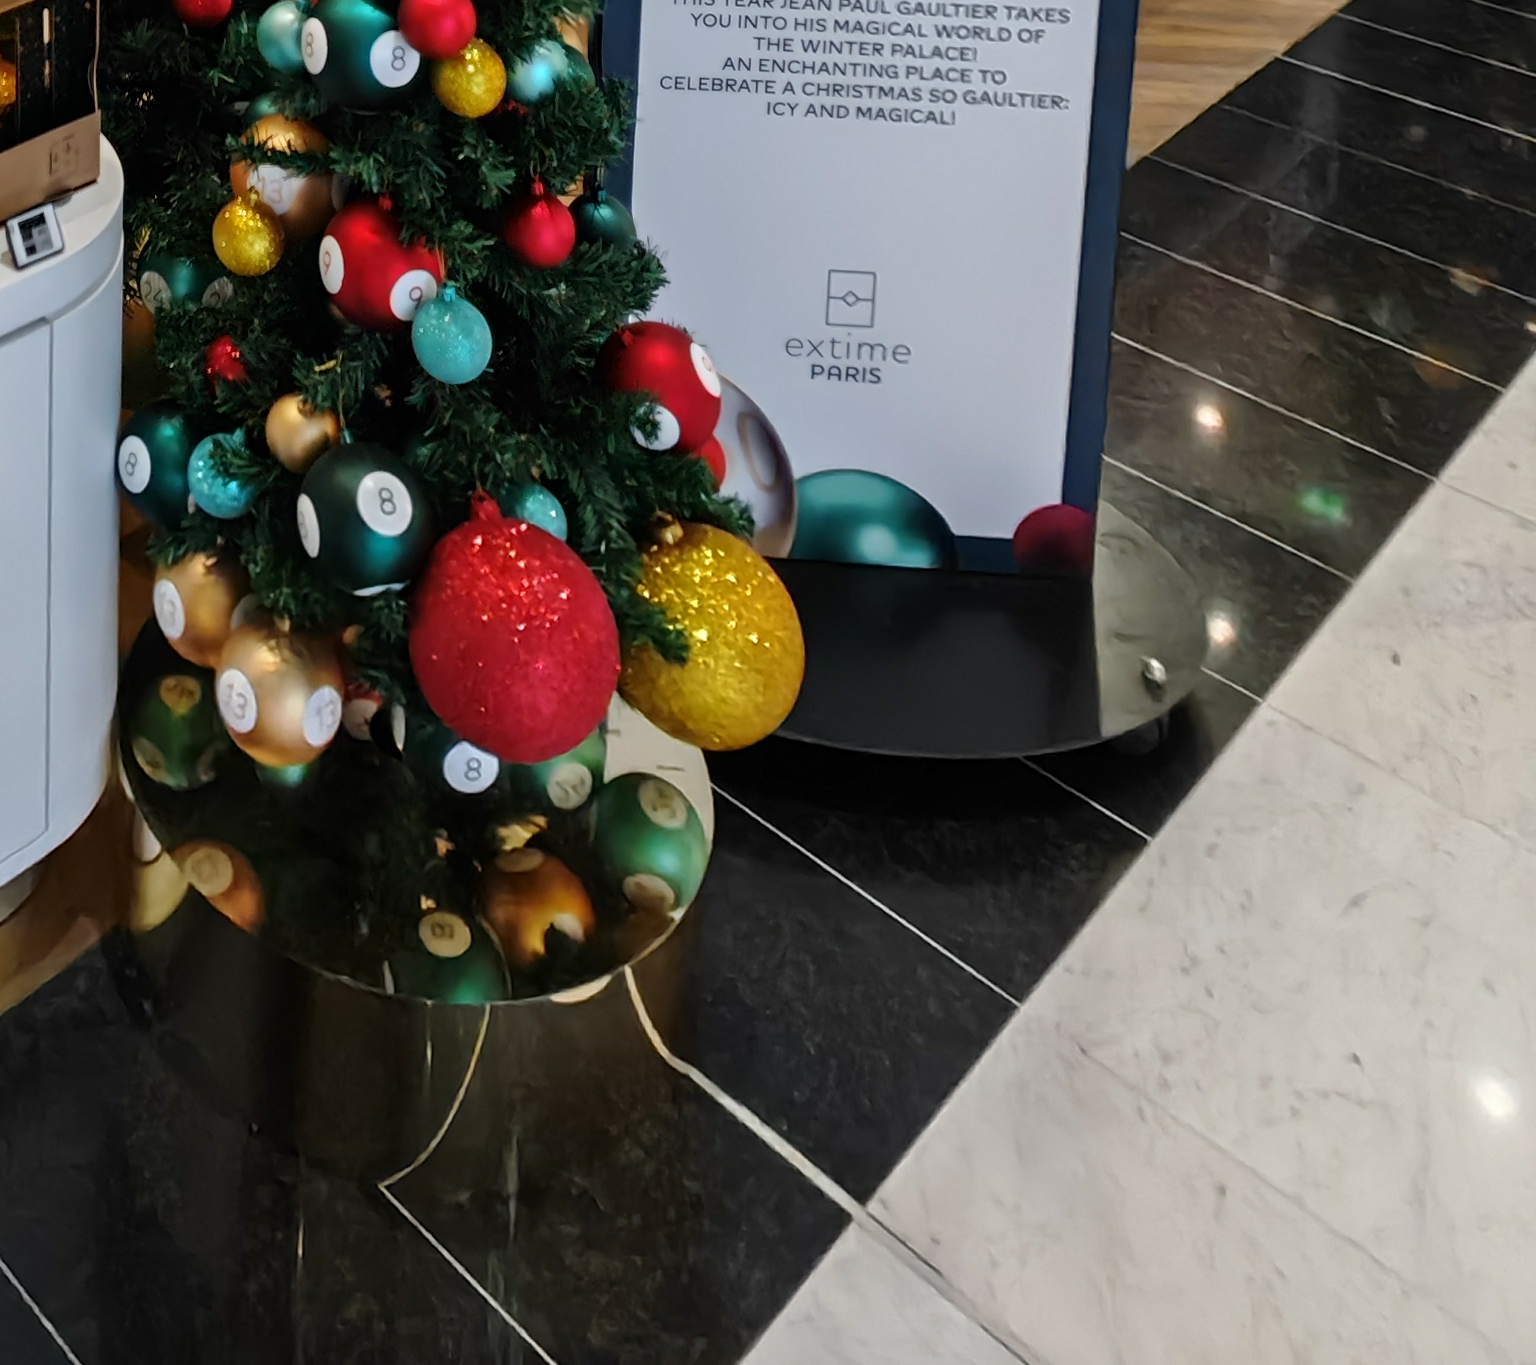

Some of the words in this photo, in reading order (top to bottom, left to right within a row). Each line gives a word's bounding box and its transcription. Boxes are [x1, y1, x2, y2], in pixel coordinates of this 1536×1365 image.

[896, 0, 998, 20] GAULTIER
[1002, 5, 1071, 24] TAKES
[690, 12, 732, 28] YOU
[737, 14, 788, 31] INTO
[793, 17, 827, 33] HIS
[833, 19, 928, 38] MAGICAL
[933, 24, 1012, 42] WORLD
[1016, 28, 1046, 44] OF
[306, 32, 314, 58] 8
[391, 45, 407, 71] 8
[752, 36, 795, 53] THE
[800, 39, 885, 57] WINTER
[890, 43, 978, 62] PALACE!
[721, 56, 752, 72] AN
[758, 58, 899, 79] ENCHANTING
[905, 65, 974, 84] PLACE
[977, 69, 1007, 86] TO
[659, 75, 777, 94] CELEBRATE
[781, 80, 796, 96] A
[801, 81, 923, 102] CHRISTMAS
[928, 88, 958, 105] SO
[961, 89, 1070, 110] GAULTIER:
[766, 101, 799, 117] ICY
[803, 103, 850, 119] AND
[855, 106, 956, 126] MAGICAL!
[324, 251, 332, 277] 9
[409, 286, 424, 311] 9
[785, 332, 913, 365] extime
[810, 364, 882, 385] PARIS
[125, 453, 138, 477] 8
[378, 487, 397, 516] 8
[464, 757, 482, 781] 8
